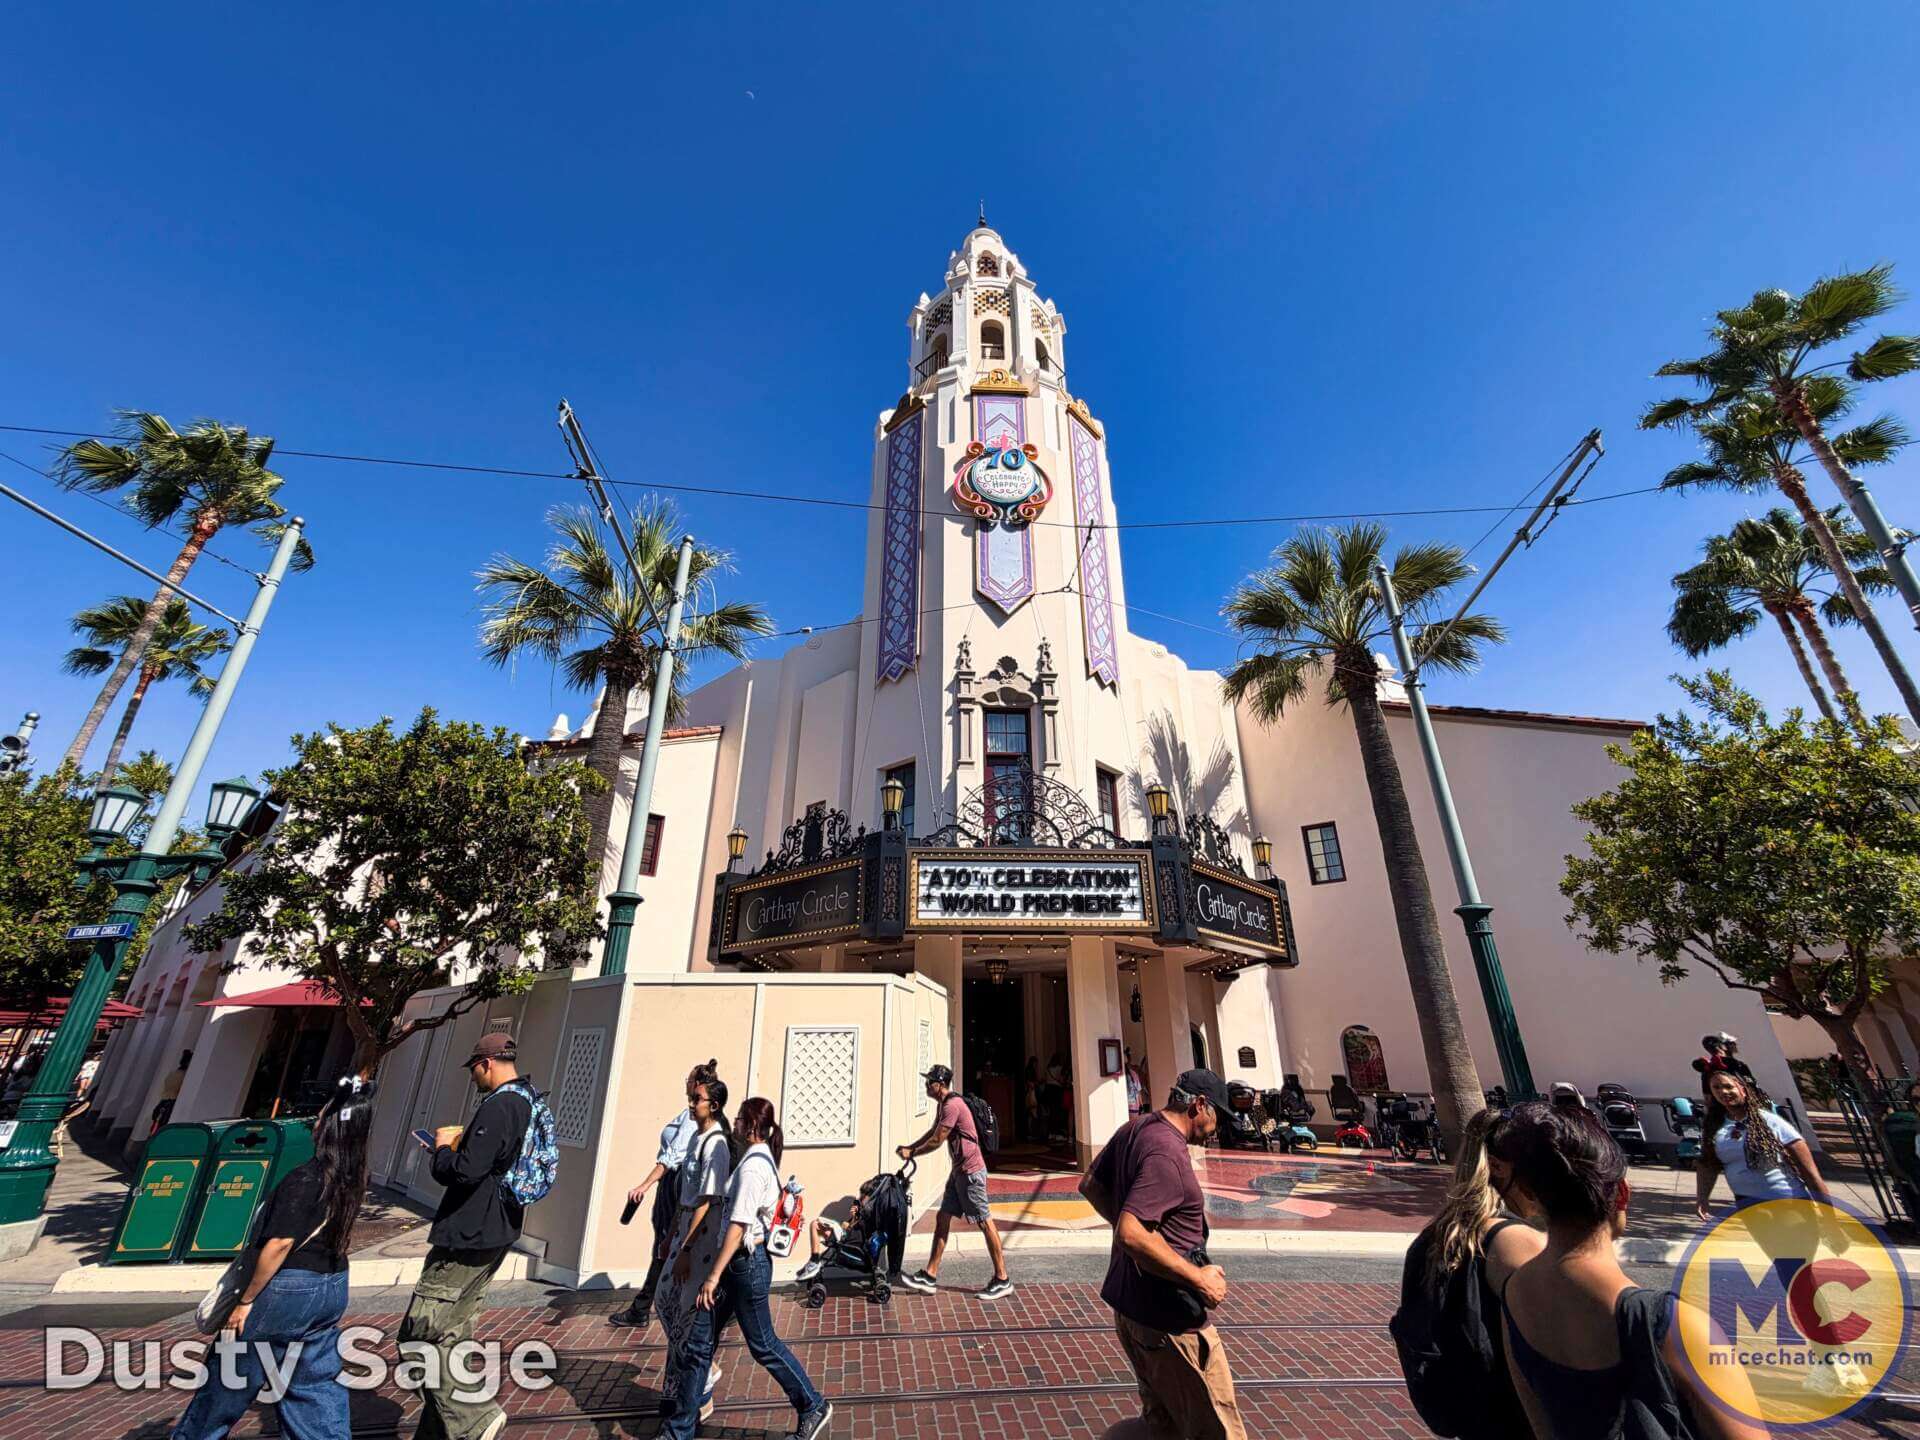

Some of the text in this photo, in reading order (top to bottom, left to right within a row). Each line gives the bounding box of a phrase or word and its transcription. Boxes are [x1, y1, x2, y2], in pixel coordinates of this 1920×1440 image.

[986, 447, 1025, 470] 70
[929, 868, 1130, 888] A 70TH CELEBRATION
[746, 897, 800, 932] Carthay
[801, 884, 849, 916] Circle
[940, 893, 1123, 912] WORLD PREMIERE
[1197, 884, 1268, 930] Carthay Circle
[73, 926, 121, 936] CARTHAY CIRCLE
